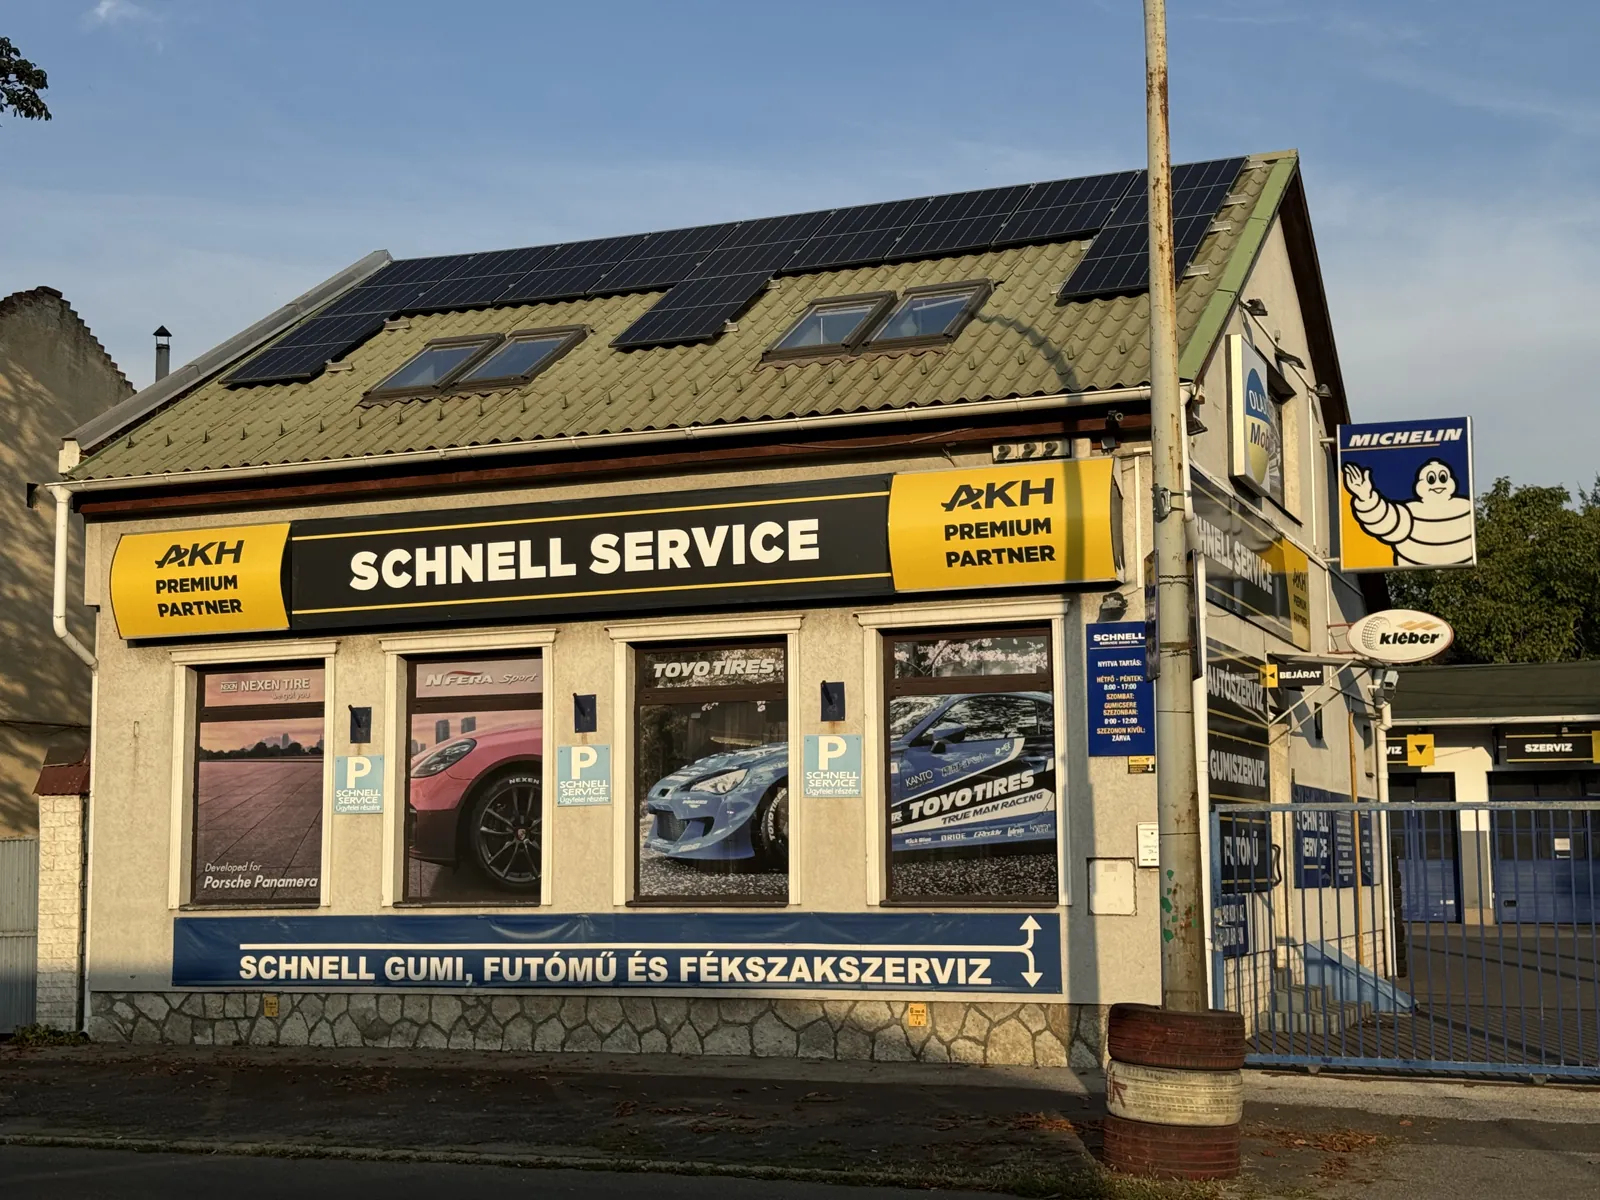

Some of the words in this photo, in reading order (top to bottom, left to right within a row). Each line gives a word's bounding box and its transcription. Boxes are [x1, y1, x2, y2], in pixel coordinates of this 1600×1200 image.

[1349, 428, 1462, 447] MICHELIN
[941, 478, 1054, 512] AKH
[944, 517, 1052, 541] PREMIUM
[155, 540, 244, 568] AKH
[349, 537, 577, 590] SCHNELL
[588, 518, 820, 574] SERVICE
[945, 545, 1056, 568] PARTNER
[1234, 540, 1273, 595] SERVICE
[156, 575, 238, 594] PREMIUM
[157, 599, 243, 617] PARTNER
[1093, 633, 1145, 642] SCHNELL
[653, 661, 710, 678] TOYO
[712, 658, 775, 676] TIRES
[1097, 660, 1118, 668] NYITVA
[1119, 658, 1142, 667] TARTÁS:
[498, 672, 539, 685] Sport
[1279, 669, 1322, 680] BEJÁRAT
[241, 679, 280, 692] NEXEN
[281, 678, 310, 689] TIRE
[1207, 664, 1264, 712] AUTÓSZERVIZ
[297, 692, 310, 700] you
[1104, 701, 1137, 709] GUMICSERE
[1097, 727, 1126, 735] SZEZONON
[1112, 734, 1131, 742] ZÁRVA
[818, 736, 847, 770] P
[1525, 743, 1573, 753] SZERVIZ
[571, 746, 598, 779] P
[1210, 749, 1266, 788] GUMISZERVIZ
[347, 756, 372, 788] P
[509, 777, 540, 785] NEXEN
[806, 771, 859, 779] SCHNELL
[905, 769, 933, 787] KANTO
[560, 780, 609, 788] SCHNELL
[562, 788, 606, 796] SERVICE
[808, 779, 856, 787] SERVICE
[336, 789, 381, 797] SCHNELL
[909, 788, 973, 820] TOYO
[973, 769, 1035, 802] TIRES
[941, 811, 971, 825] TRUE
[973, 804, 1000, 817] MAN
[1001, 791, 1045, 810] RACING
[204, 862, 248, 874] Developed
[249, 861, 262, 871] for
[203, 874, 252, 889] Porsche
[254, 874, 318, 888] Panamera
[239, 955, 375, 980] SCHNELL
[384, 956, 473, 986] GUMI,
[483, 951, 617, 982] FUTÓMŰ
[627, 950, 667, 983] ÉS
[680, 951, 992, 986] FÉKSZAKSZERVIZ
